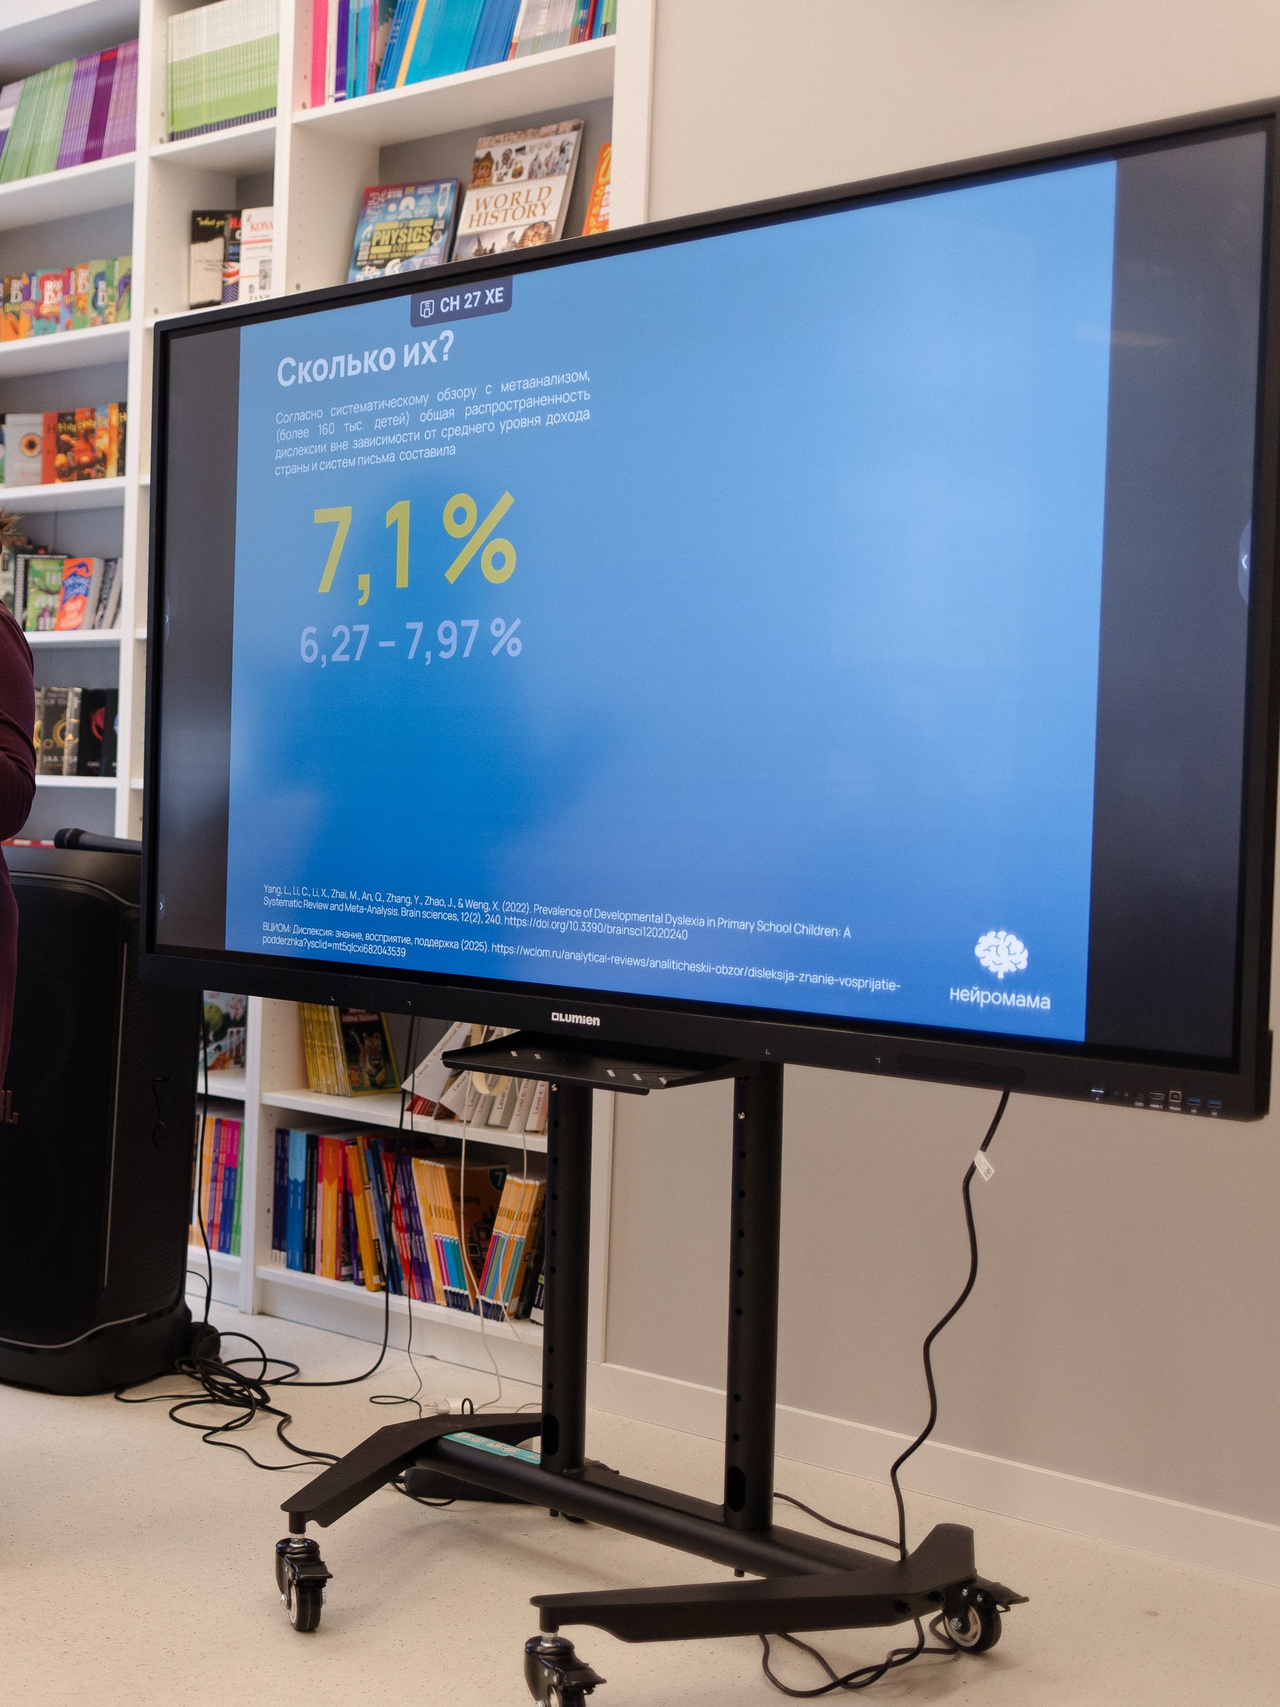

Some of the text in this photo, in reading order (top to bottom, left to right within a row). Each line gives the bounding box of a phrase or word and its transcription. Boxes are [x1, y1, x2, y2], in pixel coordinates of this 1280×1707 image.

[468, 200, 552, 228] HISTORY
[475, 186, 552, 212] WORLD
[371, 226, 432, 246] PHYSICS
[464, 292, 482, 310] 27
[277, 329, 456, 388] Сколько их?
[275, 371, 591, 425] Согласно систематическому обзору с метаанализом,
[276, 390, 591, 443] (более 160 тыс. детей) общая распространенность
[274, 408, 591, 461] дислексии вне зависимости от среднего уровня дохода
[274, 444, 457, 478] страны и систем письма составила
[313, 490, 517, 606] 7,1 %
[300, 624, 370, 668] 6,27
[405, 619, 480, 666] 7,97
[490, 617, 523, 658] %
[263, 884, 283, 897] Yang,
[292, 887, 300, 896] Li,
[301, 887, 311, 897] C.,
[312, 888, 320, 898] Li,
[331, 889, 348, 901] Zhai,
[349, 890, 360, 901] M.,
[362, 891, 374, 902] An,
[375, 892, 385, 903] Q.,
[386, 893, 412, 907] Zhang,
[413, 895, 423, 906] Y.,
[424, 896, 447, 908] Zhao,
[447, 898, 456, 909] J.,
[458, 898, 464, 908] &
[464, 899, 491, 913] Weng,
[492, 901, 500, 911] X.
[502, 901, 532, 915] (2022).
[533, 903, 582, 918] Prevalence
[583, 907, 593, 918] of
[594, 908, 663, 925] Developmental
[665, 913, 705, 928] Dyslexia
[707, 916, 716, 928] in
[717, 917, 755, 933] Primary
[756, 920, 792, 934] School
[793, 922, 841, 938] Children:
[843, 927, 852, 938] A
[263, 896, 689, 941] Systematic Review and Meta-Analysis. Brain sciences, 12(2), 240. https://doi.org/10.3390/brainsci12020240
[262, 921, 292, 933] ВЦИОМ:
[292, 924, 334, 938] Дислексия:
[335, 929, 364, 941] знание,
[365, 932, 413, 946] восприятие,
[414, 936, 459, 950] поддержка
[460, 938, 490, 953] (2025).
[949, 986, 1051, 1010] нейромама
[494, 1171, 504, 1187] 7
